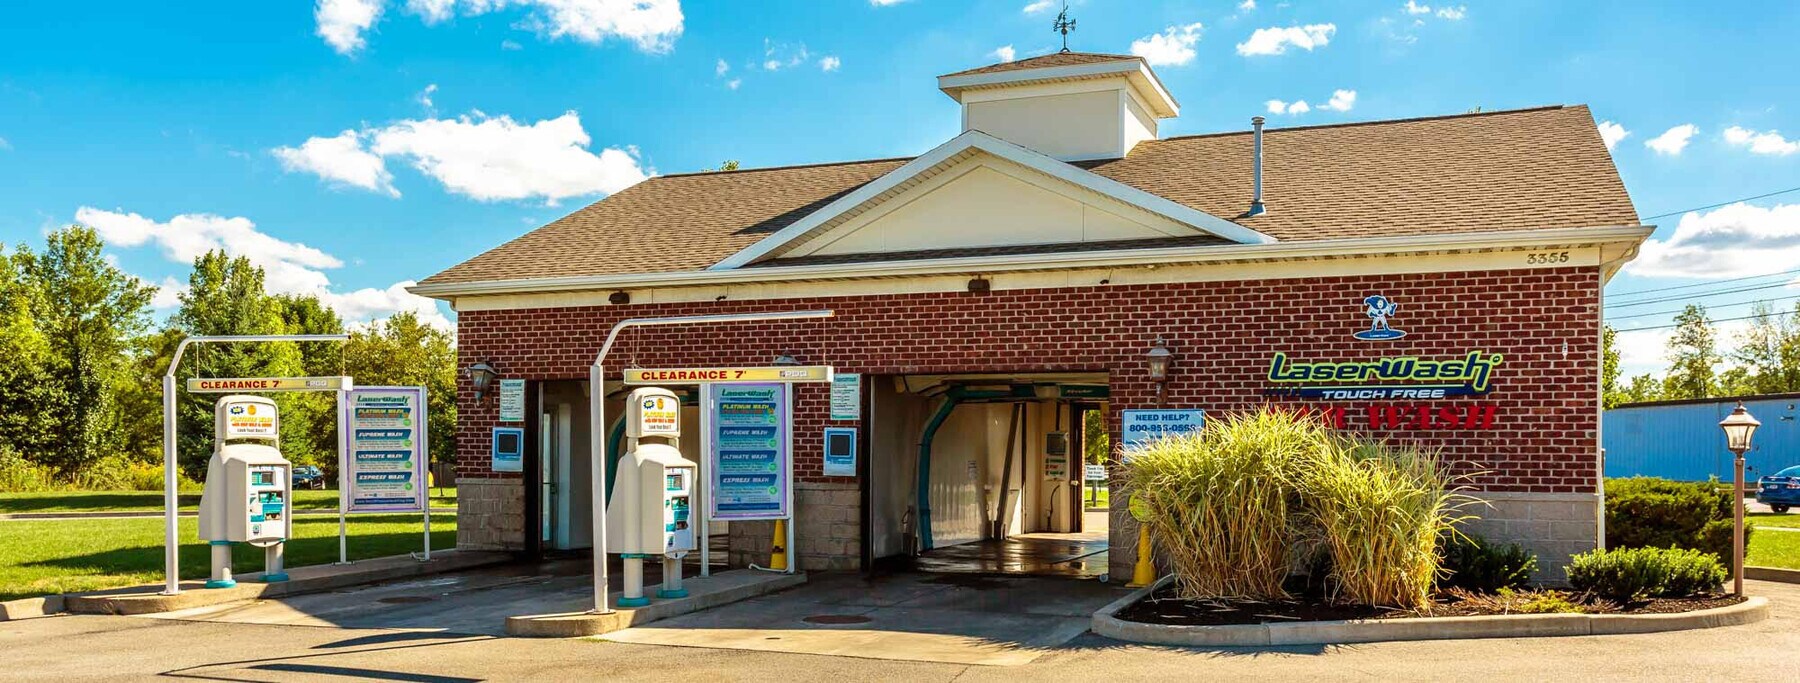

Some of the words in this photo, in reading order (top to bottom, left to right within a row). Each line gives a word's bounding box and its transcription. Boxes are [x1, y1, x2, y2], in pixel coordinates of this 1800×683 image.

[1527, 251, 1569, 264] 3355
[641, 370, 728, 381] CLEARANCE
[201, 380, 267, 389] CLEARANCE
[1322, 390, 1390, 399] TOUCH
[1391, 389, 1446, 399] FREE
[1161, 413, 1190, 421] HELP?
[1367, 405, 1500, 430] WASH
